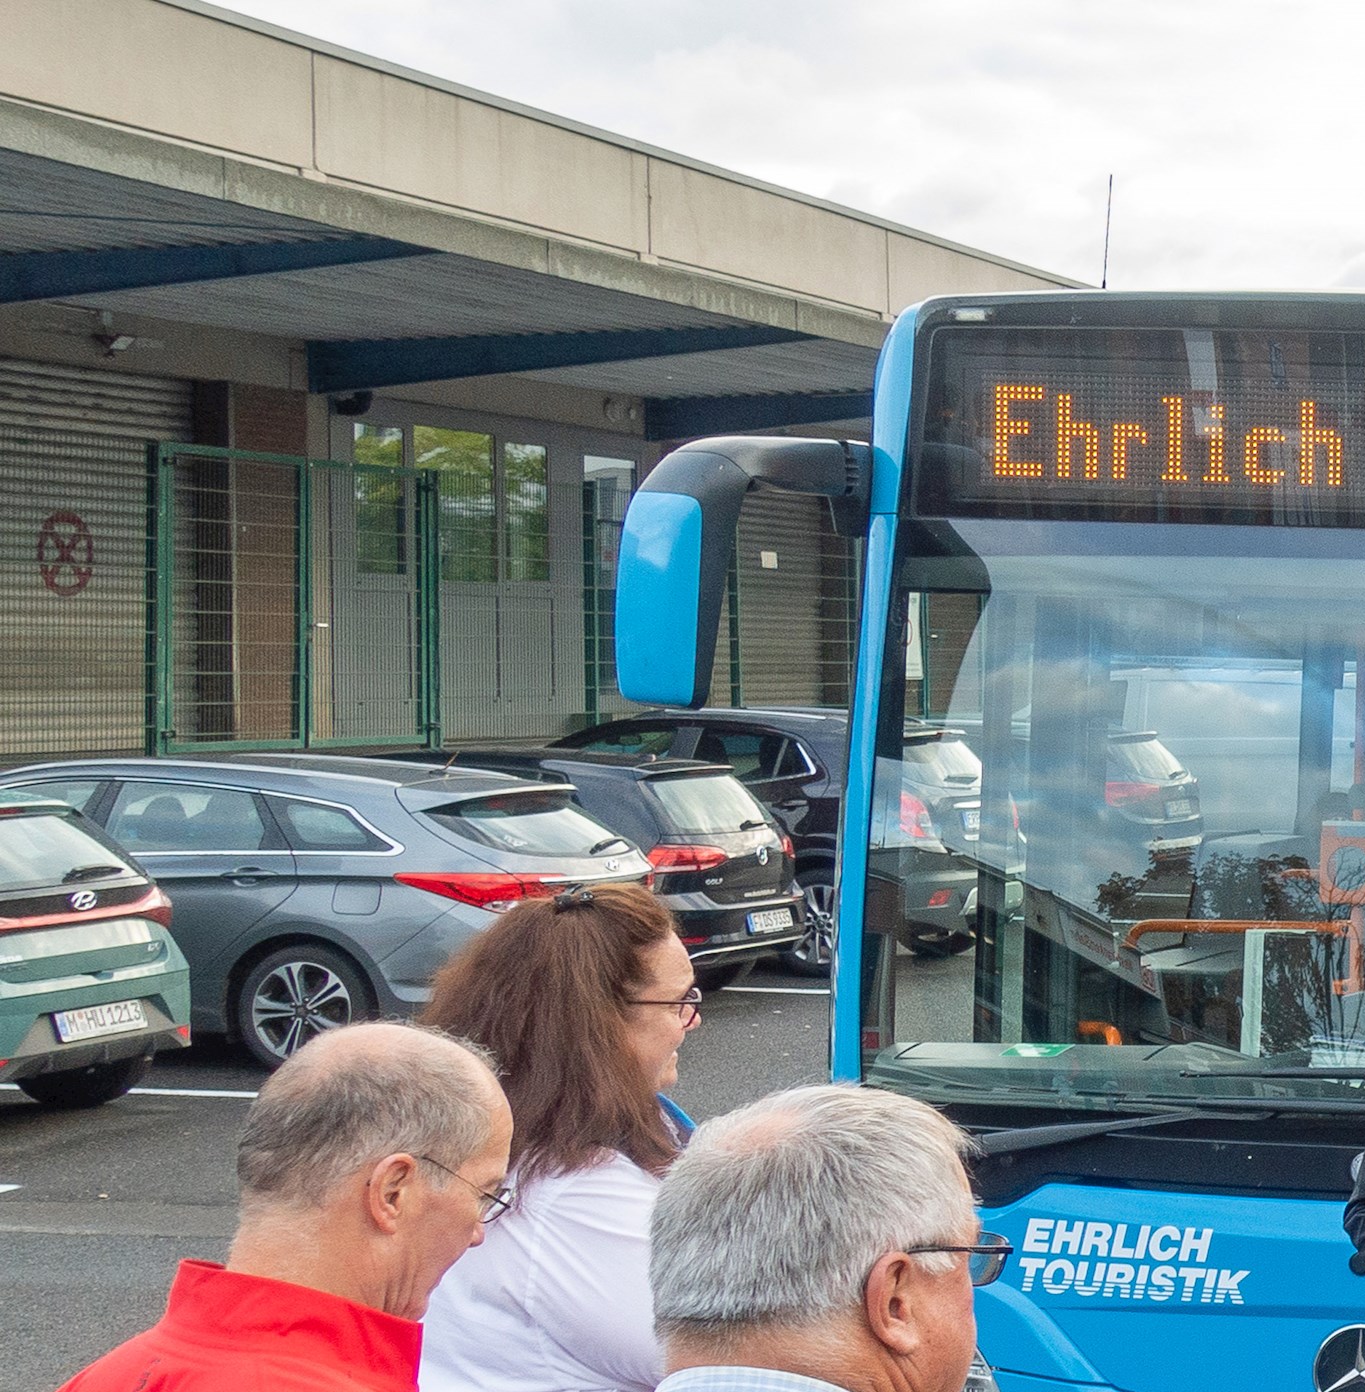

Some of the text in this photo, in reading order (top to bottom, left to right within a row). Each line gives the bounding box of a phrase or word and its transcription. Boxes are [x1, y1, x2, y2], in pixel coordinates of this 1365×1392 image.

[994, 385, 1343, 487] Ehrlich
[66, 1002, 141, 1033] M HU 1213
[1022, 1217, 1214, 1263] EHRLICH
[1019, 1257, 1251, 1305] TOURISTIK
